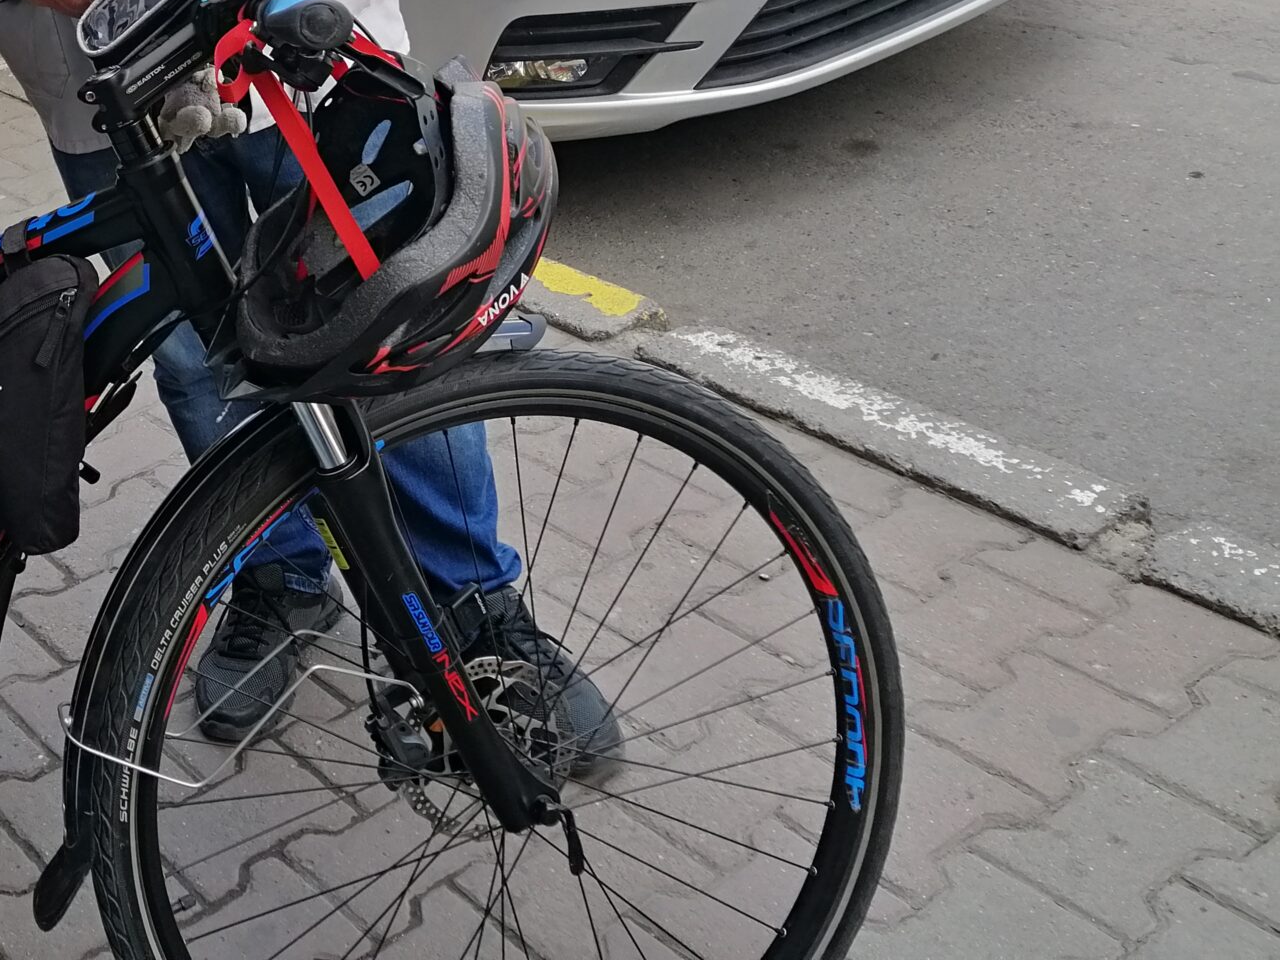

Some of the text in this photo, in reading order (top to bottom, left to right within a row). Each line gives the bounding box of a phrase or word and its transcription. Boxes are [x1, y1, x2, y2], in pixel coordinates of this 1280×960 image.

[136, 64, 166, 87] EASTON
[119, 726, 139, 823] SCHWALBE
[151, 628, 174, 671] DELTA
[170, 575, 204, 629] CRUISER
[202, 541, 228, 575] PLUS
[413, 609, 442, 652] SUNTOUR
[435, 652, 480, 722] NEX
